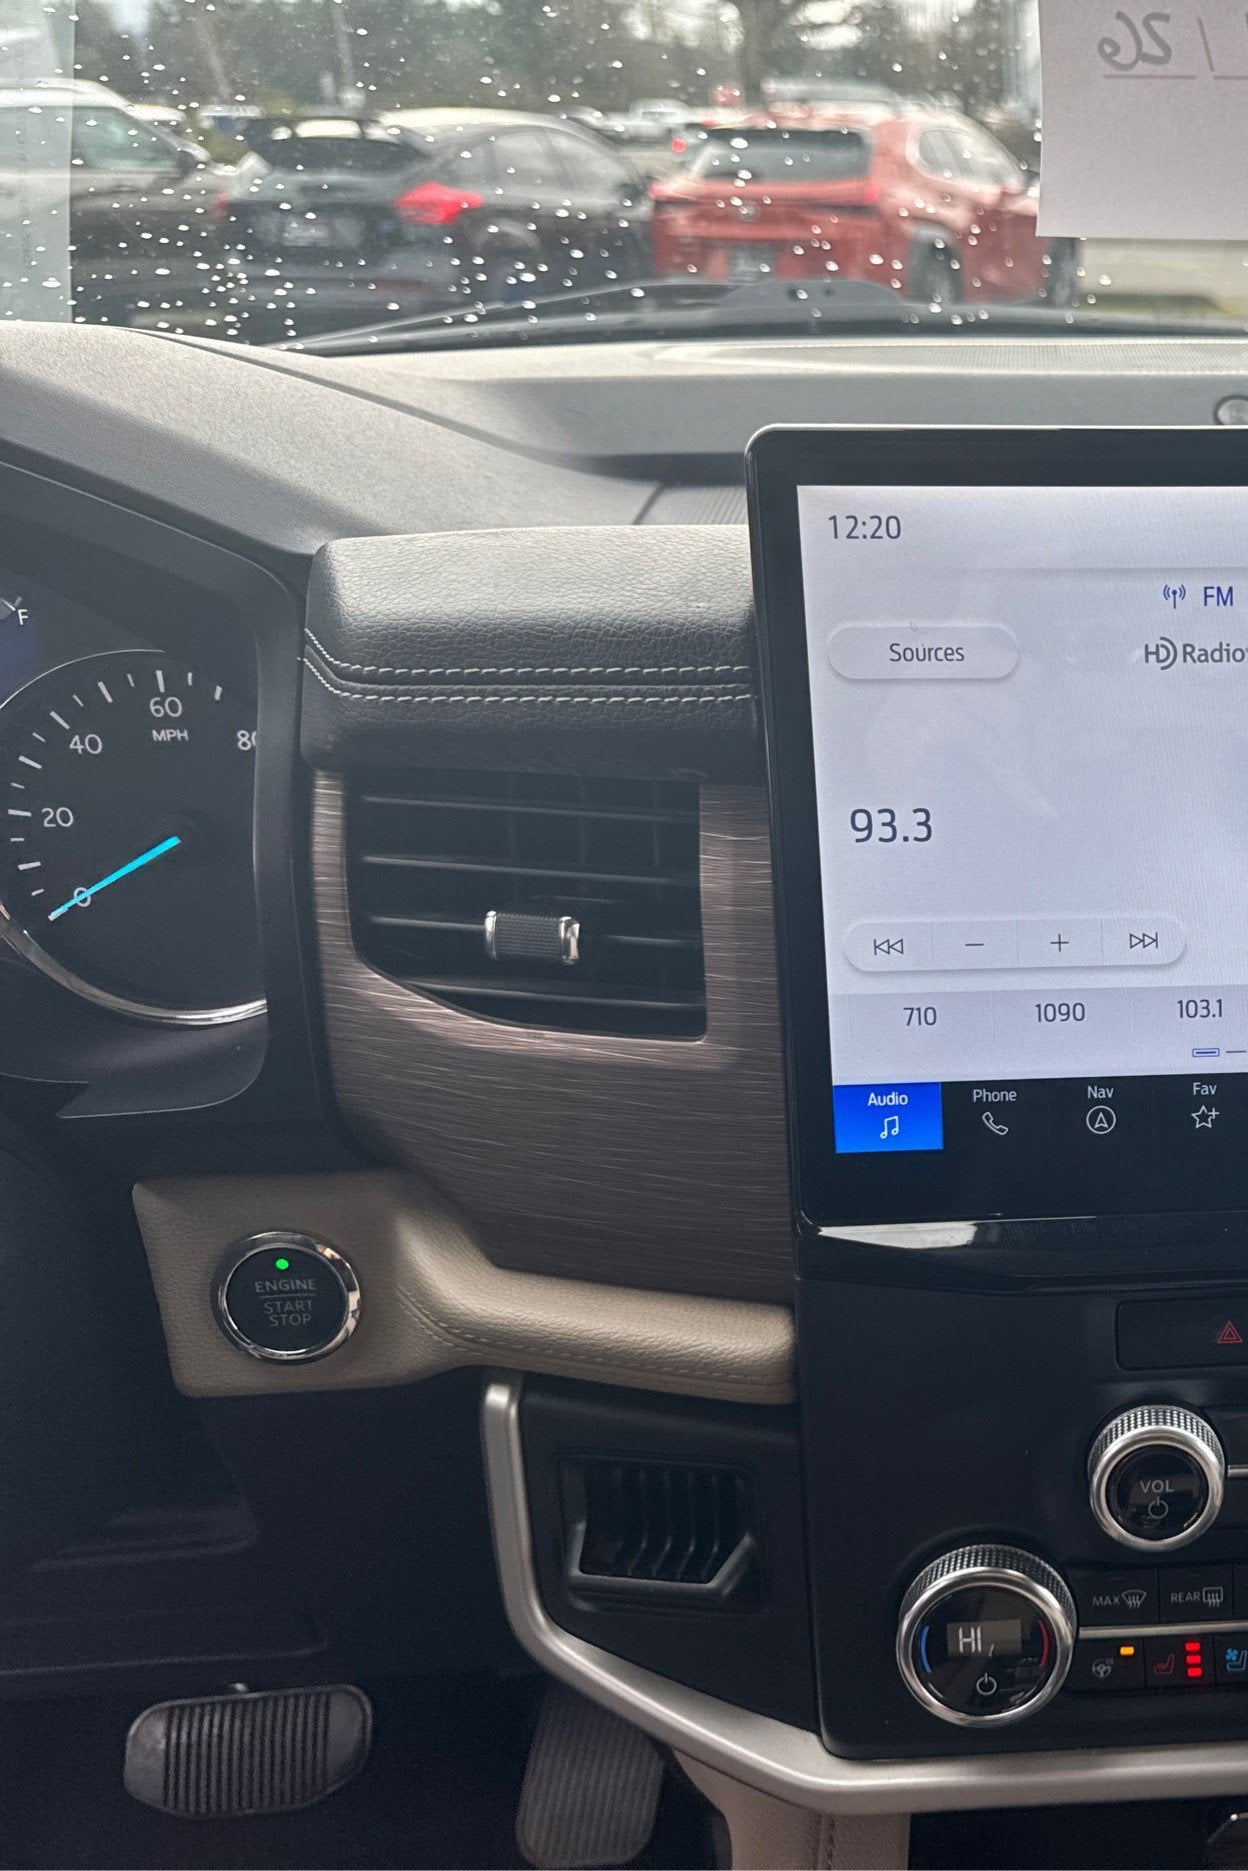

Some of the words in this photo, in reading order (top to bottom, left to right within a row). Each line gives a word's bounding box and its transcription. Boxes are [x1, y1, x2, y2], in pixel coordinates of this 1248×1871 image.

[827, 514, 902, 540] 12:20
[1203, 585, 1234, 607] FM
[17, 608, 29, 626] F
[889, 642, 965, 663] Sources
[1143, 635, 1179, 671] HD
[149, 696, 183, 718] 60
[68, 733, 104, 755] 40
[151, 728, 189, 742] MPH
[41, 806, 74, 828] 20
[850, 807, 933, 844] 93.3
[902, 1006, 937, 1027] 710
[1034, 1002, 1086, 1023] 1090
[1176, 998, 1223, 1019] 103.1
[972, 1088, 1018, 1103] Phone
[1087, 1085, 1115, 1099] Nav
[1192, 1081, 1218, 1096] Fav
[867, 1091, 909, 1107] Audio
[255, 1278, 317, 1293] ENGINE
[263, 1300, 314, 1315] START
[268, 1314, 313, 1328] STOP
[1139, 1478, 1175, 1495] VOL
[1092, 1594, 1121, 1607] MAX
[1170, 1590, 1201, 1603] REAR
[957, 1626, 983, 1655] HI
